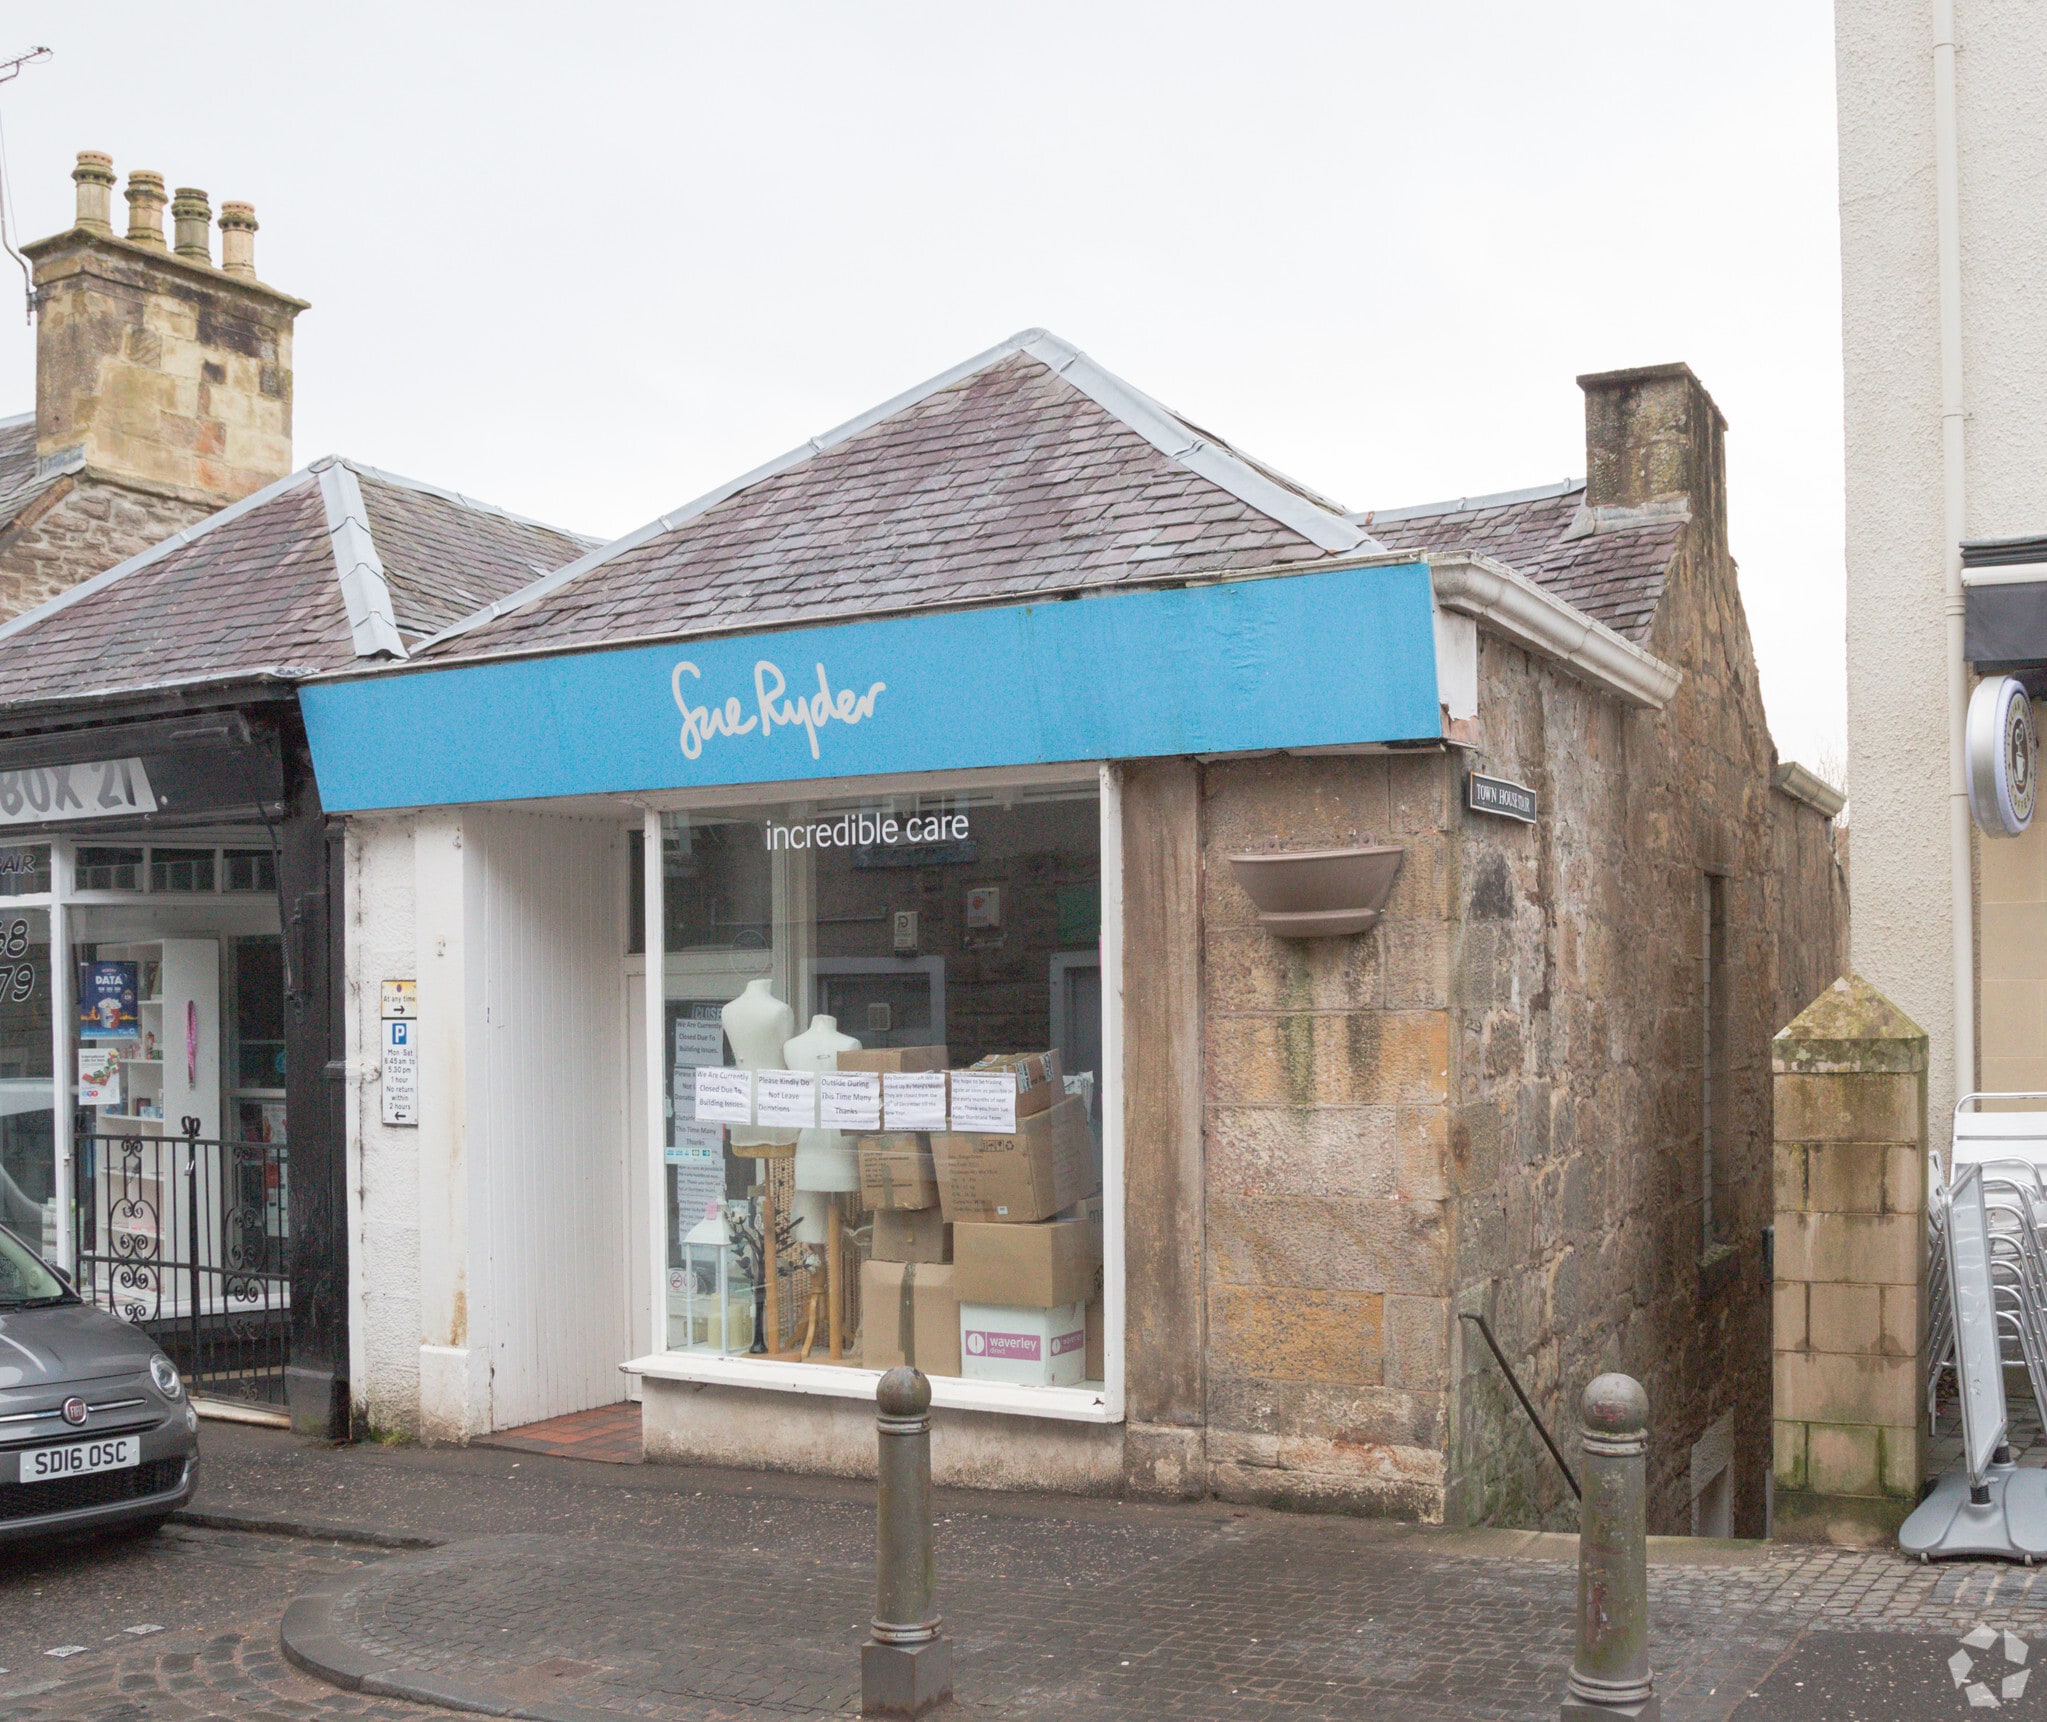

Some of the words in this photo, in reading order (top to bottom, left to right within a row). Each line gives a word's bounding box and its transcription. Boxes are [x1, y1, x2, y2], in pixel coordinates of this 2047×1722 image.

[671, 661, 758, 760] Sue
[754, 660, 887, 760] Ryder
[1476, 783, 1497, 803] TOWN
[766, 812, 899, 851] incredible
[905, 814, 969, 843] care
[95, 975, 124, 985] DATA
[697, 1022, 722, 1030] Currently
[395, 1025, 405, 1043] P
[720, 1072, 749, 1081] Currently
[758, 1077, 780, 1085] Please
[780, 1078, 799, 1086] Kindly
[821, 1079, 846, 1087] Outside
[847, 1080, 870, 1089] During
[700, 1084, 719, 1092] Closed
[768, 1091, 780, 1099] Not
[781, 1092, 799, 1100] Leave
[853, 1094, 871, 1102] Many
[699, 1099, 723, 1108] Building
[758, 1104, 790, 1112] Donations
[834, 1107, 858, 1115] Thanks
[701, 1127, 716, 1135] Many
[989, 1337, 1037, 1351] waverley
[35, 1447, 83, 1475] SD16
[89, 1440, 128, 1467] OSC
